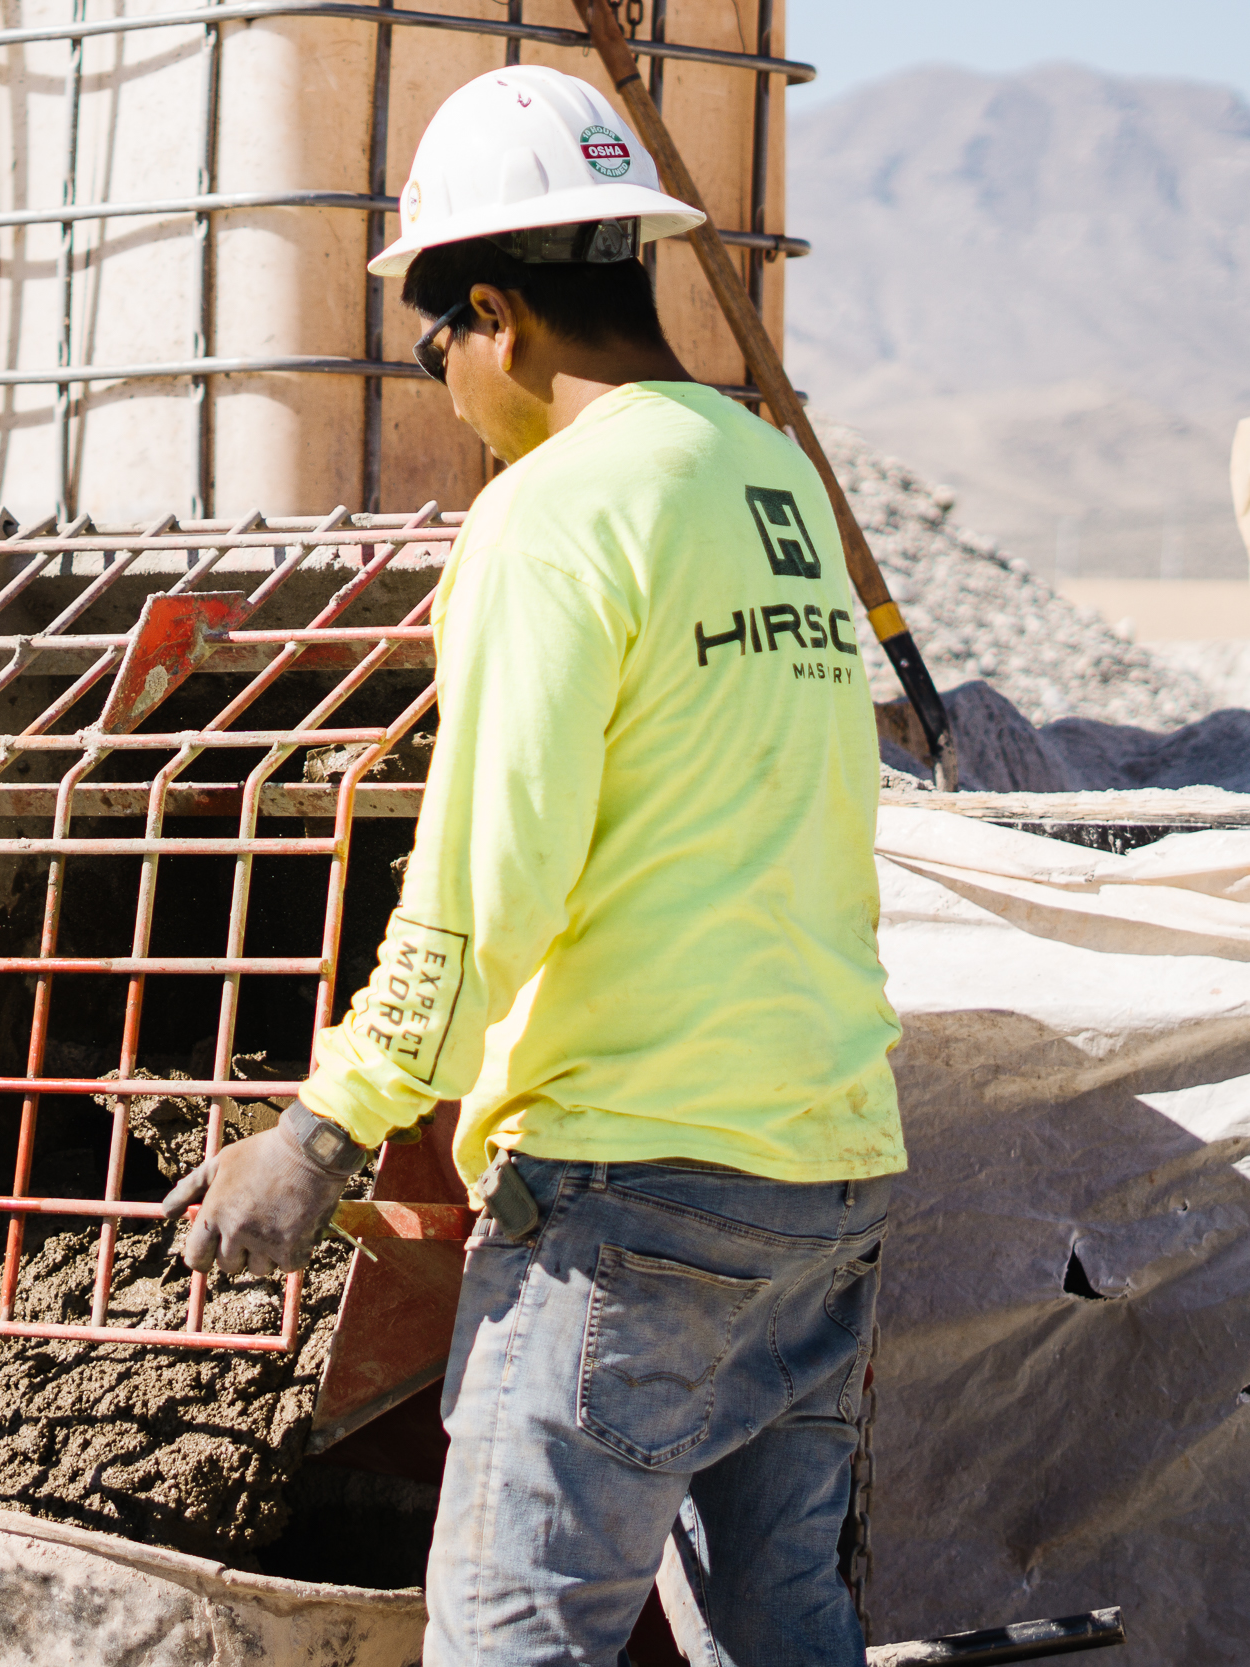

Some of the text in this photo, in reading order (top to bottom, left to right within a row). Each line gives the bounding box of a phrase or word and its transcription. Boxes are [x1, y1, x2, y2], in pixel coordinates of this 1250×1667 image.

[582, 126, 616, 138] 10 HOUR
[588, 145, 624, 157] OSHA
[595, 162, 628, 177] TRAINED
[694, 603, 858, 667] HIRSC
[366, 940, 418, 1051] MORE
[397, 949, 447, 1060] EXPECT
